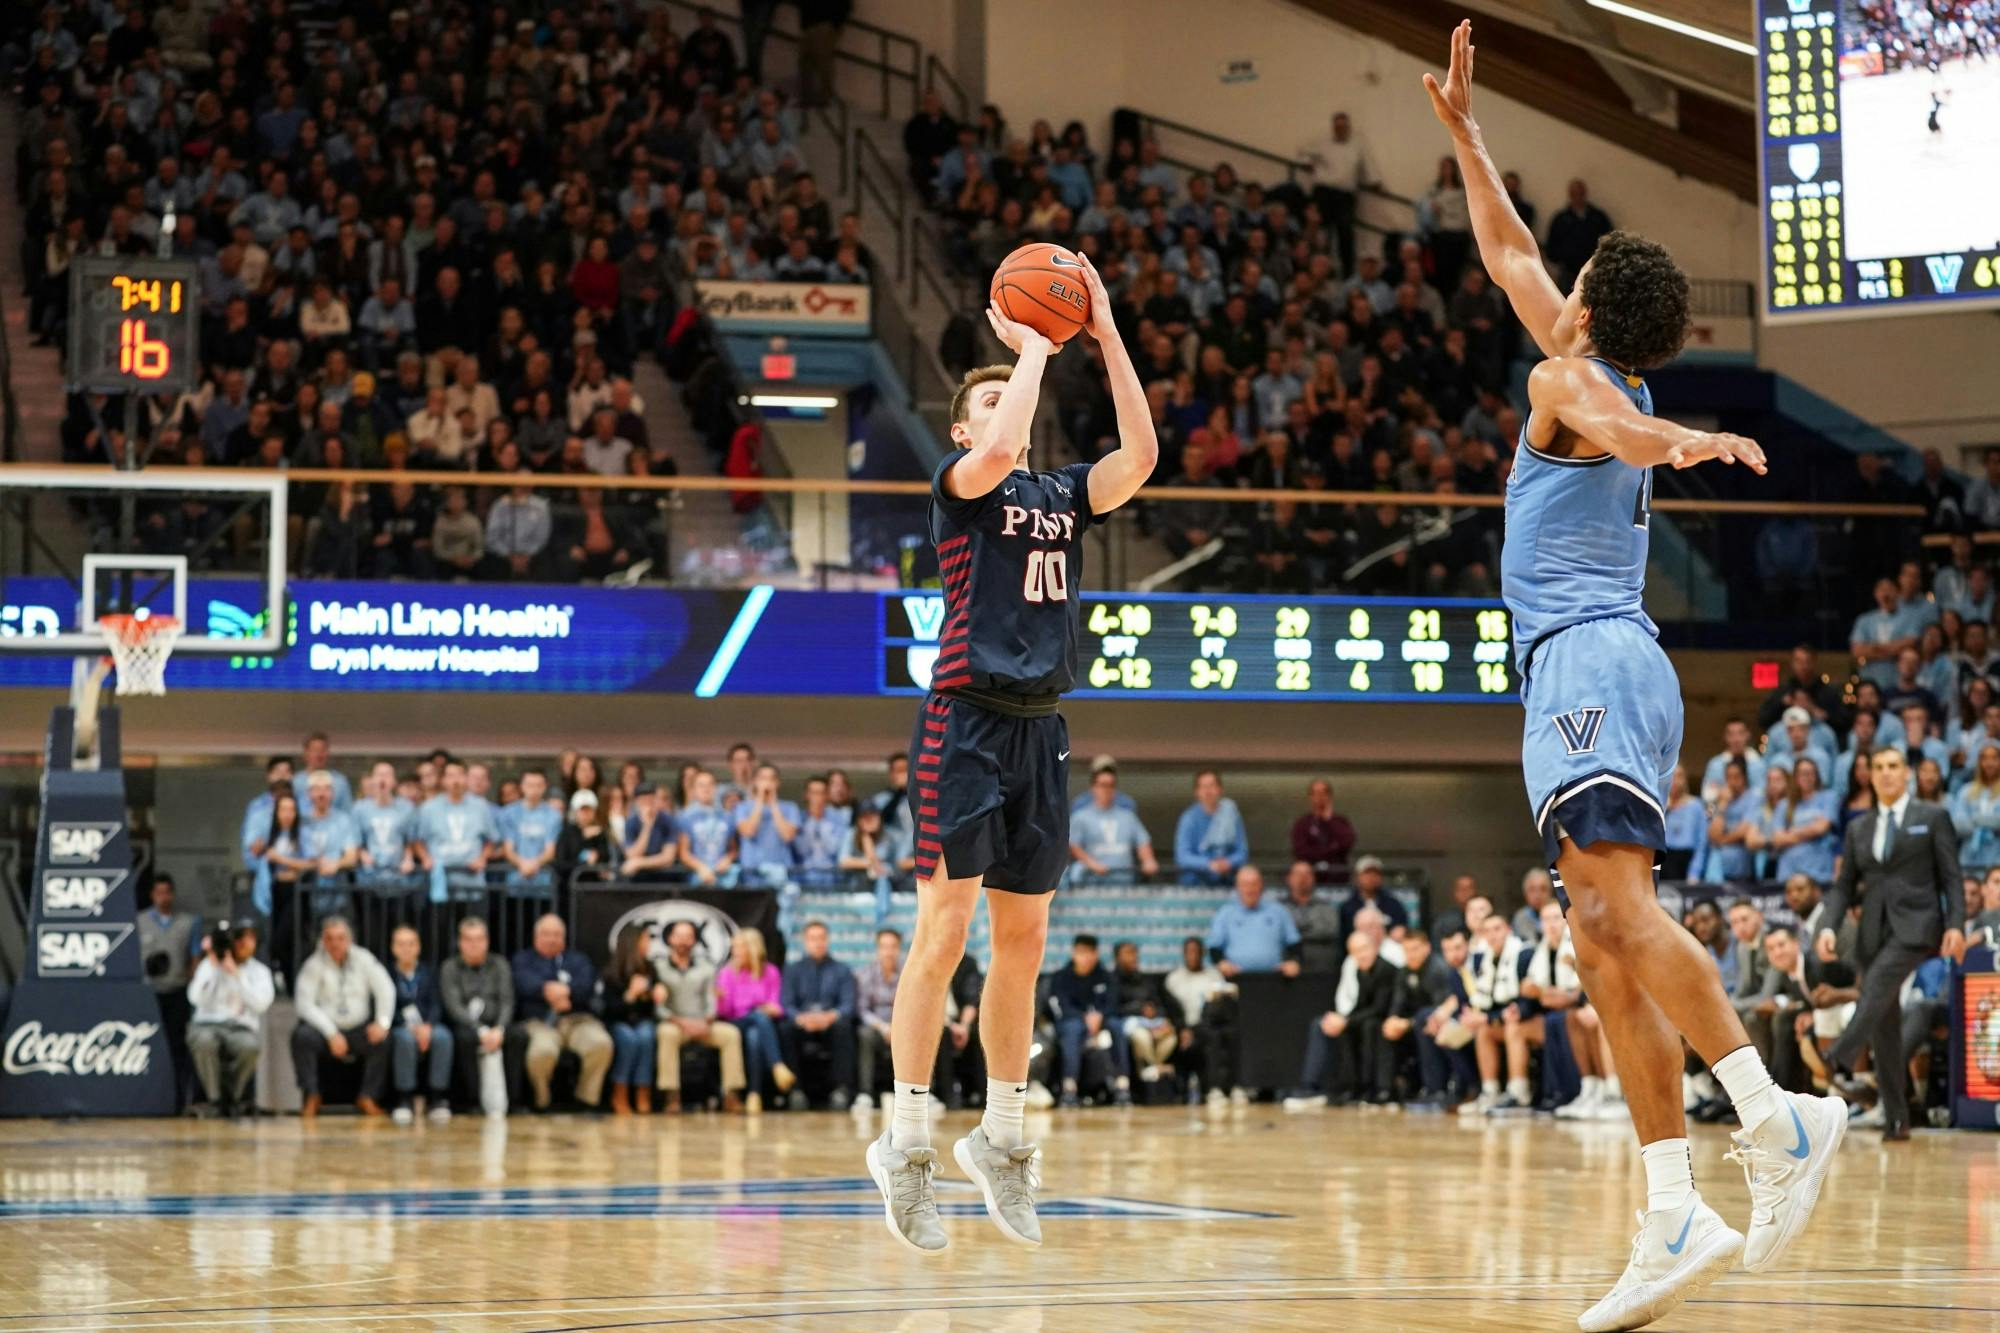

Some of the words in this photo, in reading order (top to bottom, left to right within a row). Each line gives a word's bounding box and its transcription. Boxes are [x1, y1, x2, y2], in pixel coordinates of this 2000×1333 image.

[111, 275, 182, 313] 7:41
[1048, 281, 1087, 309] ELITE
[120, 318, 171, 379] 16
[1024, 550, 1068, 602] 00
[310, 601, 389, 635] Main
[392, 602, 462, 636] Line
[1276, 606, 1310, 638] 29
[1408, 609, 1441, 641] 21
[438, 645, 539, 676] Hospital
[1089, 658, 1151, 688] 6-12
[1190, 659, 1238, 689] 3-7
[1276, 660, 1310, 690] 22
[1476, 662, 1508, 693] 16
[1551, 706, 1607, 756] V
[51, 829, 104, 857] SAP
[44, 877, 108, 910] SAP
[39, 932, 110, 968] SAP
[3, 1020, 160, 1076] Coca-Cola
